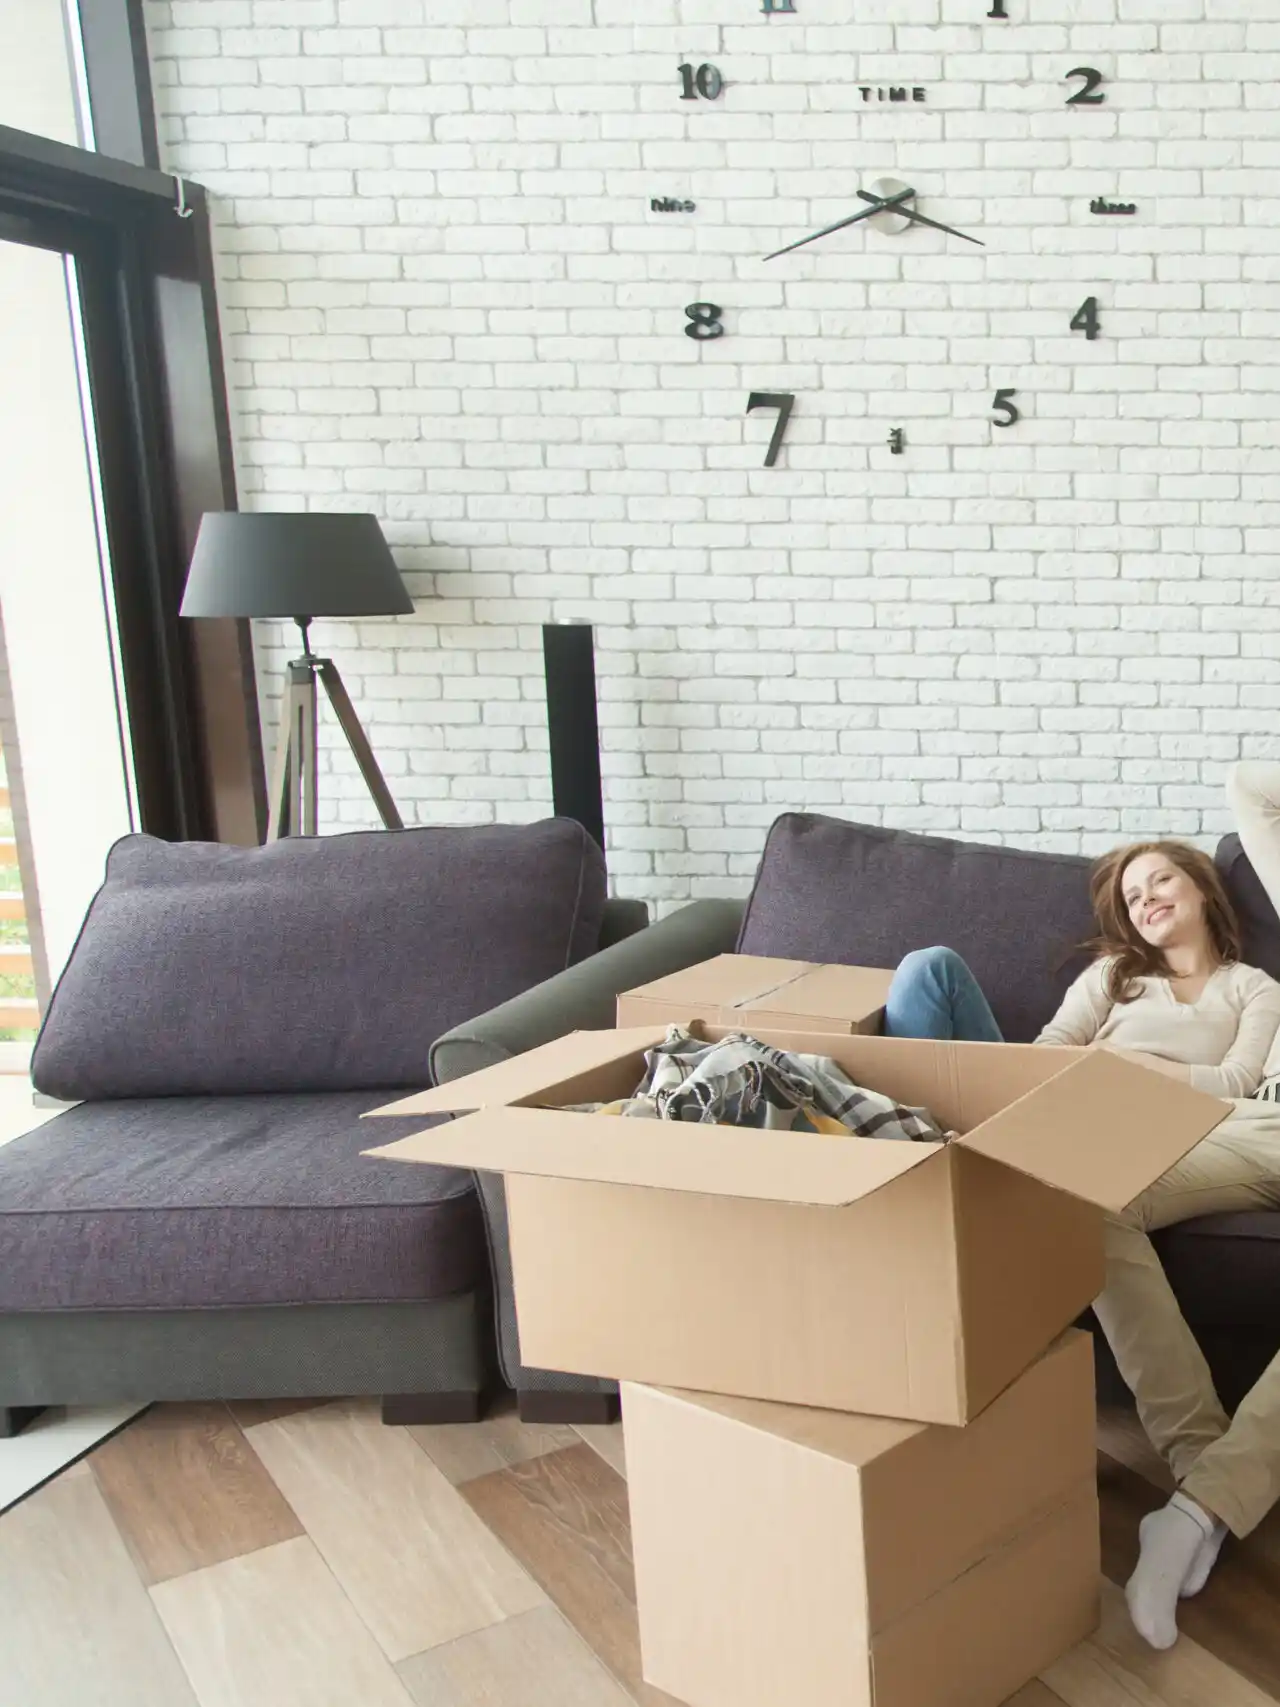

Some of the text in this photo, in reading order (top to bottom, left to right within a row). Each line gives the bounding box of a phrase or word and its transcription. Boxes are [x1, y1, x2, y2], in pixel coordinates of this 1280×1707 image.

[677, 63, 724, 101] 10
[858, 87, 925, 102] TIME
[1065, 67, 1105, 104] 2
[684, 302, 724, 341] 8
[1070, 296, 1101, 341] 4
[992, 388, 1019, 427] 5
[746, 391, 795, 467] 7
